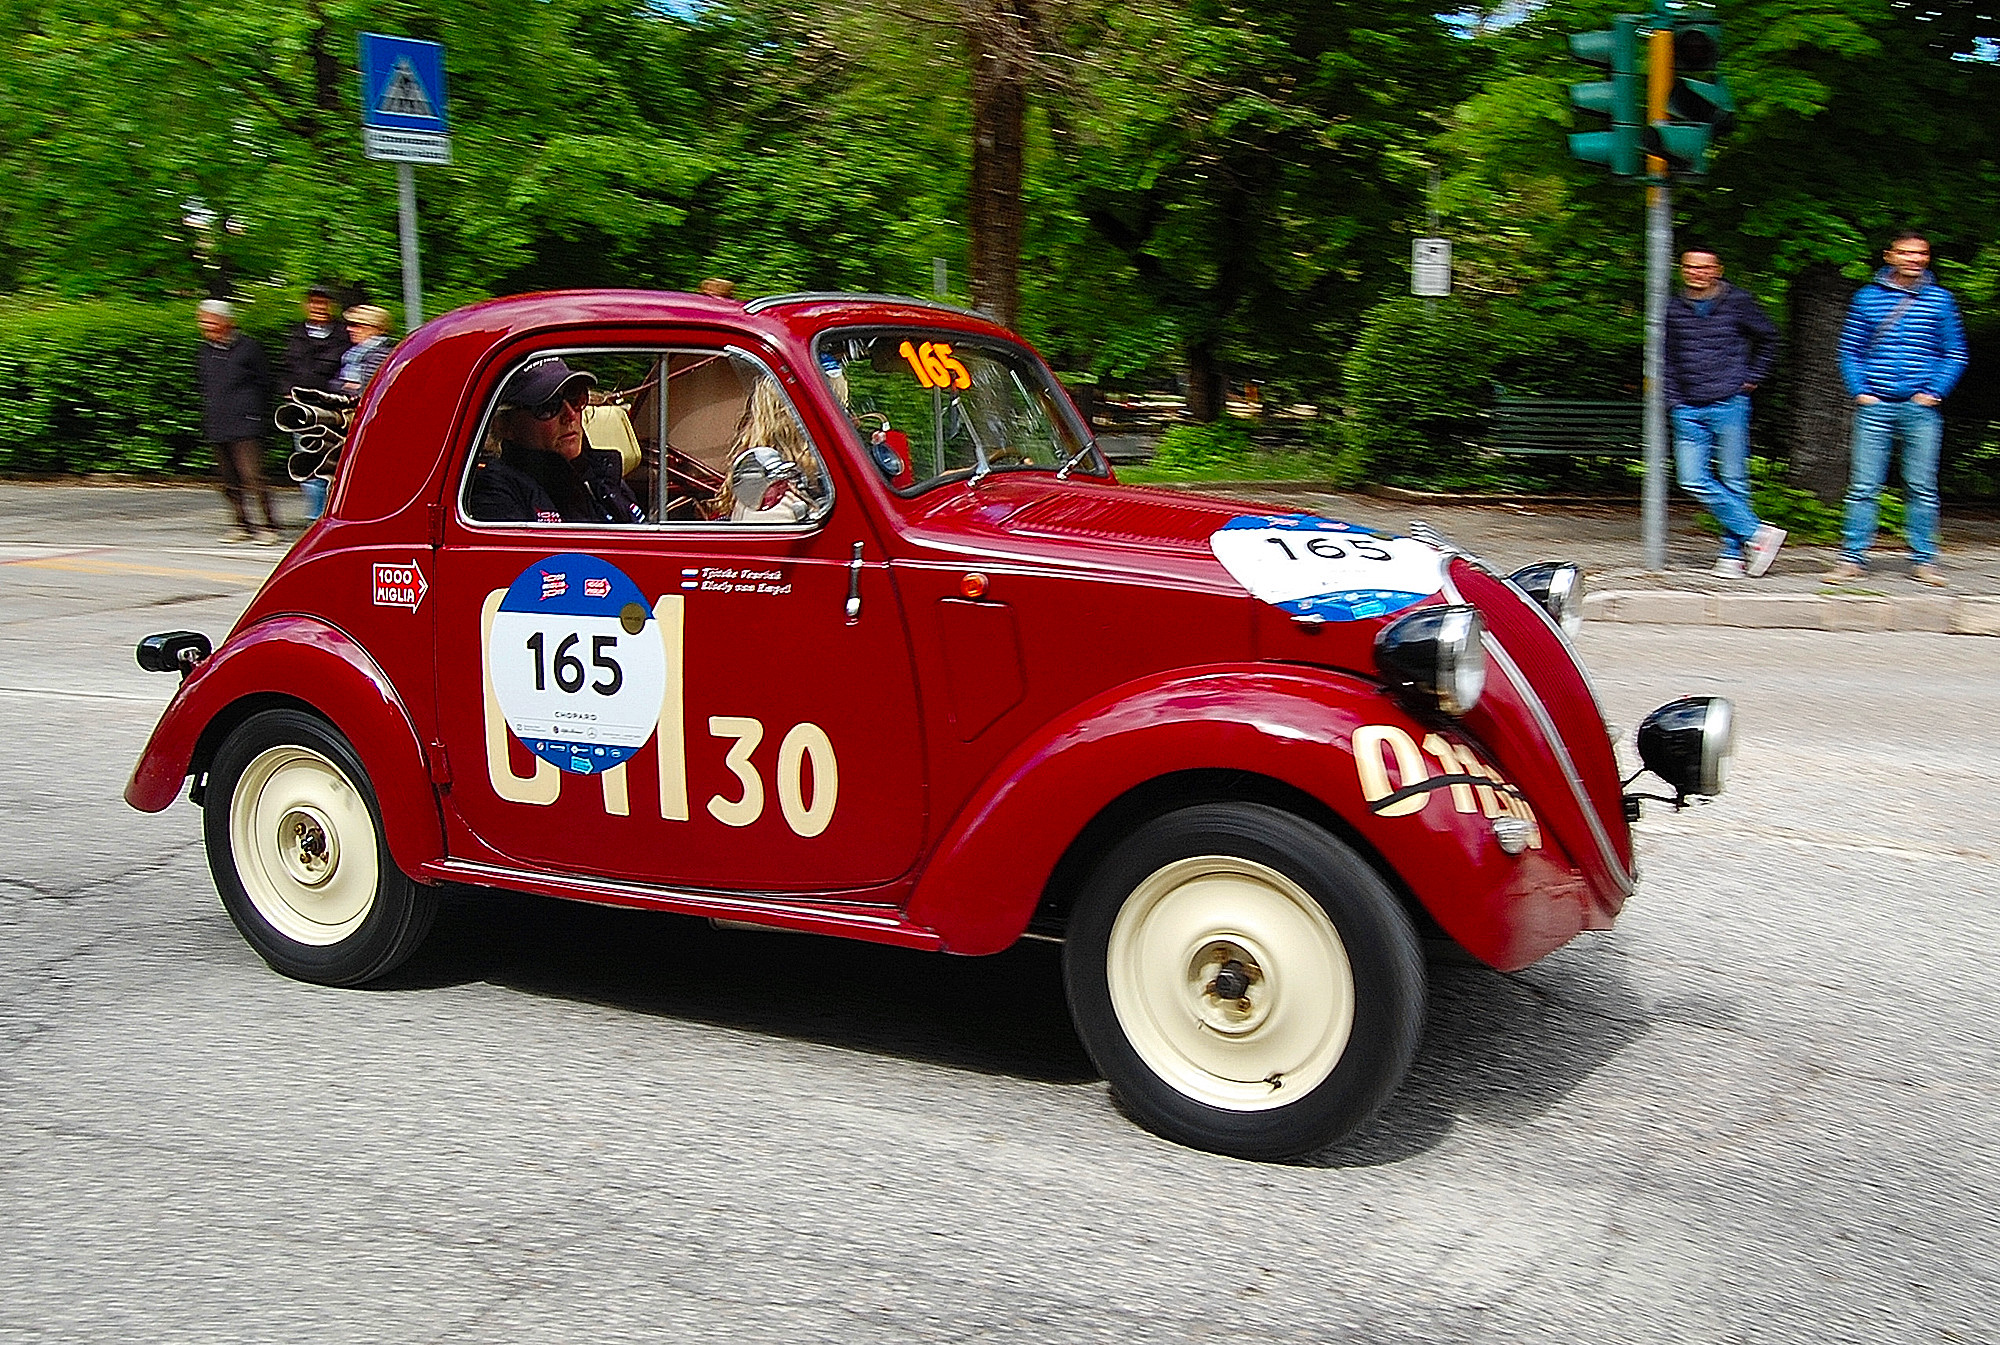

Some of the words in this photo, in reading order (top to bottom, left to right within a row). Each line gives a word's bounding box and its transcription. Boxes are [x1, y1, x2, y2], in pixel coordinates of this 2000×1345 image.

[899, 340, 972, 389] 165
[1266, 537, 1392, 561] 165
[376, 586, 415, 603] MIGLIA
[378, 568, 413, 585] 1000
[526, 632, 623, 696] 165
[706, 716, 839, 838] 30
